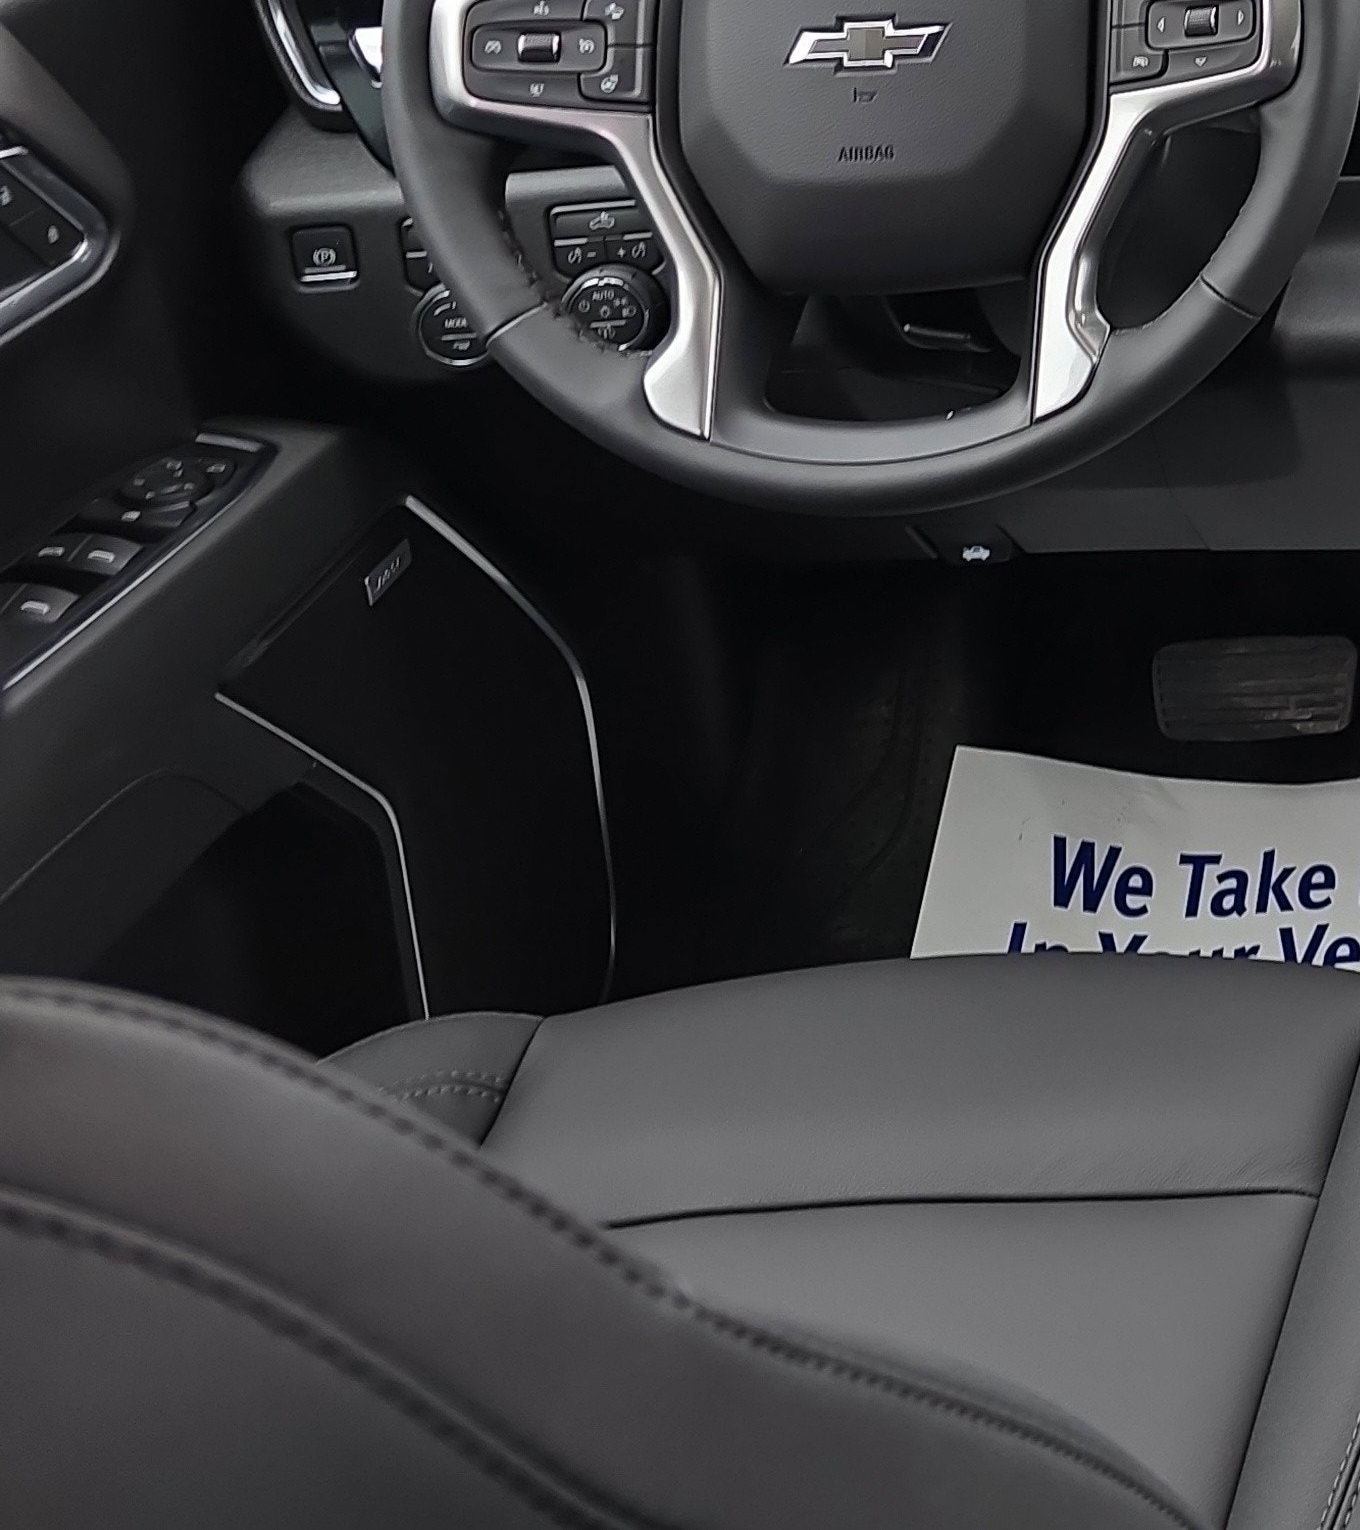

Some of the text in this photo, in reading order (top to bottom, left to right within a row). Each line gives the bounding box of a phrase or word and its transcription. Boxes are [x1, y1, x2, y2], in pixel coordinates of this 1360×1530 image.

[837, 144, 894, 162] AIRBAG
[591, 290, 614, 302] AUTO
[1051, 833, 1154, 918] We
[1178, 848, 1337, 920] Take
